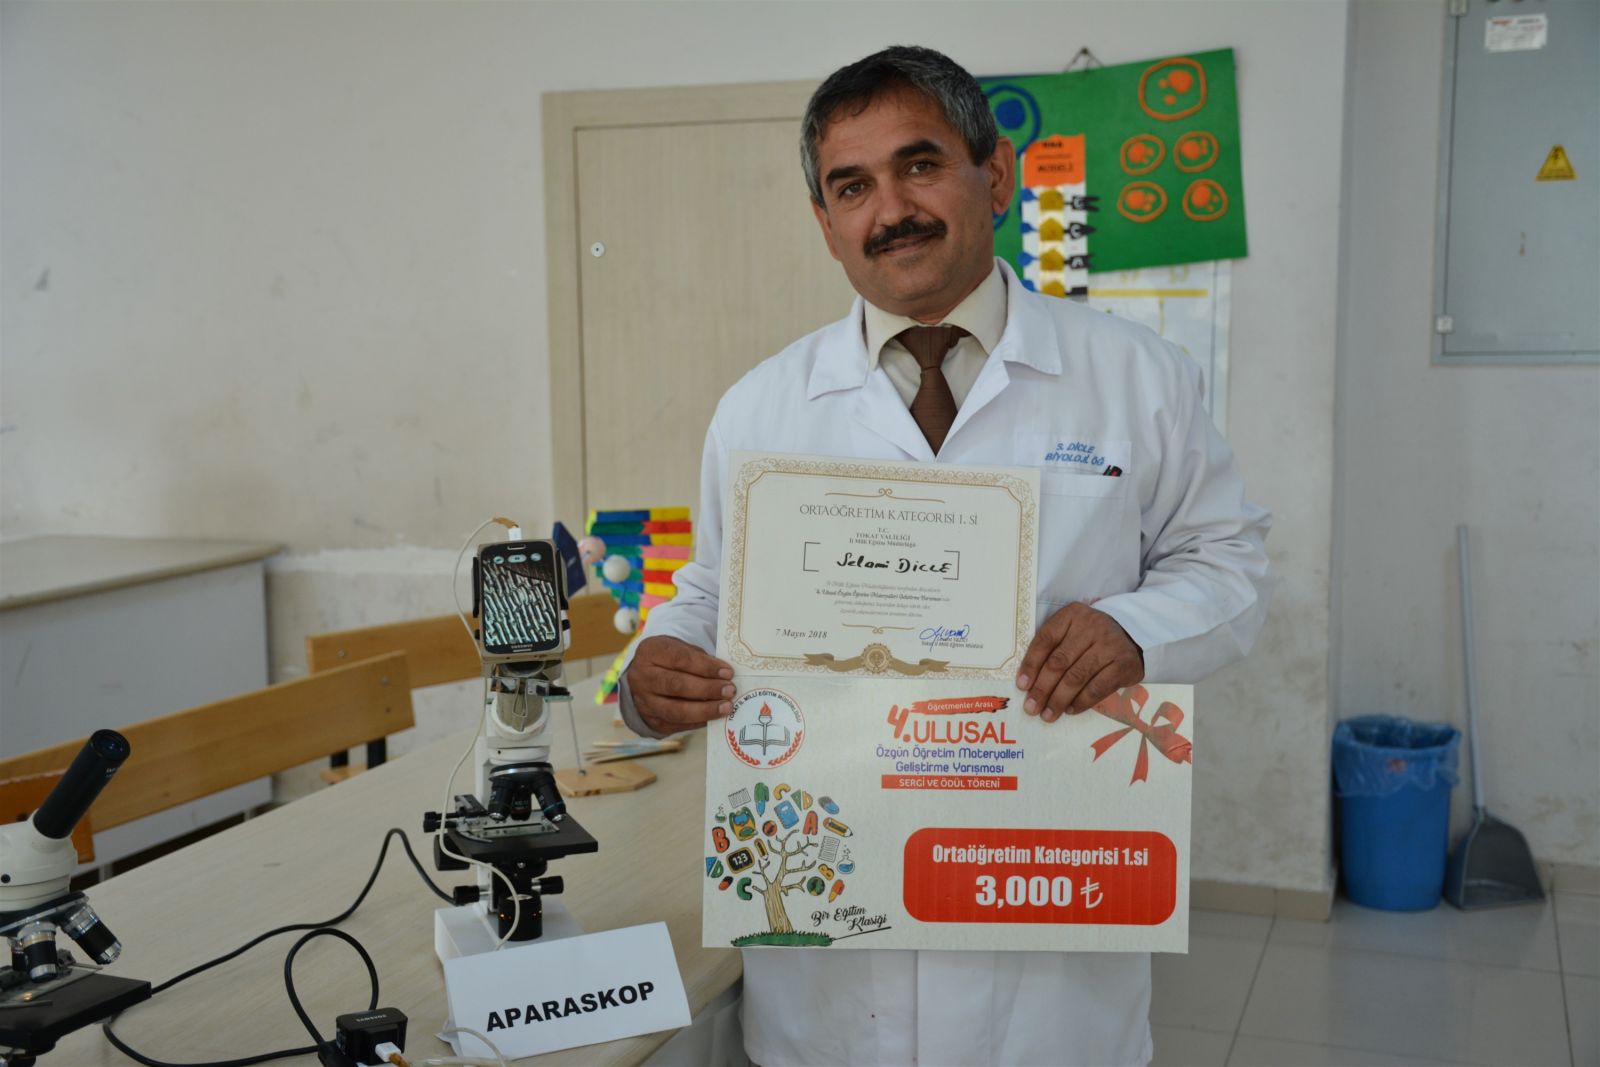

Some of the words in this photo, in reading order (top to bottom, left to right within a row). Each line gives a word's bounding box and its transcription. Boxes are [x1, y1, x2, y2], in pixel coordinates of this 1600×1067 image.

[799, 504, 885, 520] ORTAÖĞRETİM
[888, 508, 955, 525] KATEGORİSİ
[775, 628, 781, 638] 7
[808, 630, 828, 640] 2018
[927, 700, 974, 711] Öğretmenler
[876, 744, 909, 760] Özgün
[912, 744, 955, 761] Öğretim
[958, 747, 1025, 762] Materyalleri
[896, 760, 949, 775] Geliştirme
[952, 762, 1005, 776] Yarışması
[899, 777, 926, 788] SERGİ
[927, 779, 939, 788] VE
[940, 777, 966, 789] ÖDÜL
[967, 777, 1001, 789] TÖRENİ
[731, 852, 749, 867] 123
[932, 843, 1031, 866] Ortaöğretim
[1035, 845, 1119, 867] Kategorisi
[1122, 847, 1149, 866] 1.si
[975, 875, 1073, 909] 3,000
[811, 910, 832, 927] Bir
[833, 904, 867, 922] Eğitim
[847, 913, 888, 932] Klasiği
[486, 981, 655, 1032] APARASKOP
